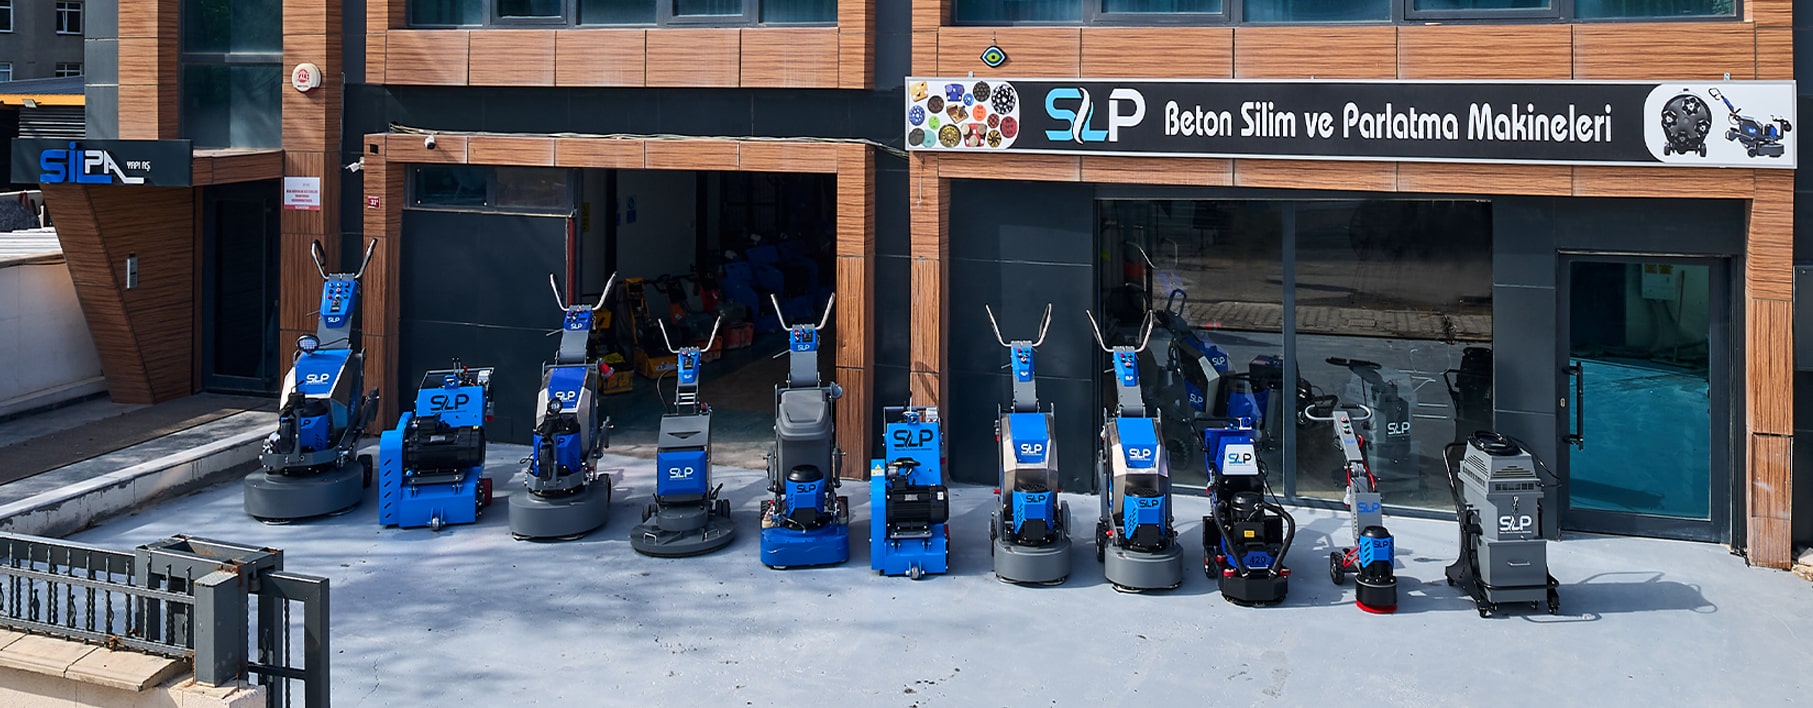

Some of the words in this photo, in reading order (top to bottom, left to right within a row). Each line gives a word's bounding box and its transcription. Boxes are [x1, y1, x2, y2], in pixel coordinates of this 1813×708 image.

[1045, 87, 1147, 144] SLP
[1165, 100, 1233, 137] Beton
[1240, 101, 1297, 138] Silim
[1304, 112, 1335, 139] ve
[1343, 102, 1460, 140] Parlatma
[1467, 102, 1613, 142] Makineleri
[1212, 356, 1226, 366] SLP
[305, 373, 330, 384] SLP
[429, 393, 470, 412] SLP
[1189, 393, 1204, 404] SLP
[1387, 421, 1411, 436] SLP
[892, 429, 934, 449] SLP
[1020, 443, 1043, 454] SLP
[1128, 448, 1152, 459] SLP
[1228, 453, 1252, 465] SLP
[669, 466, 694, 479] SLP
[796, 484, 817, 494] SLP
[1026, 494, 1046, 503] SLP
[1138, 499, 1159, 508] SLP
[1357, 502, 1381, 513] SLP
[1499, 515, 1532, 531] SLP
[1373, 540, 1389, 549] SLP
